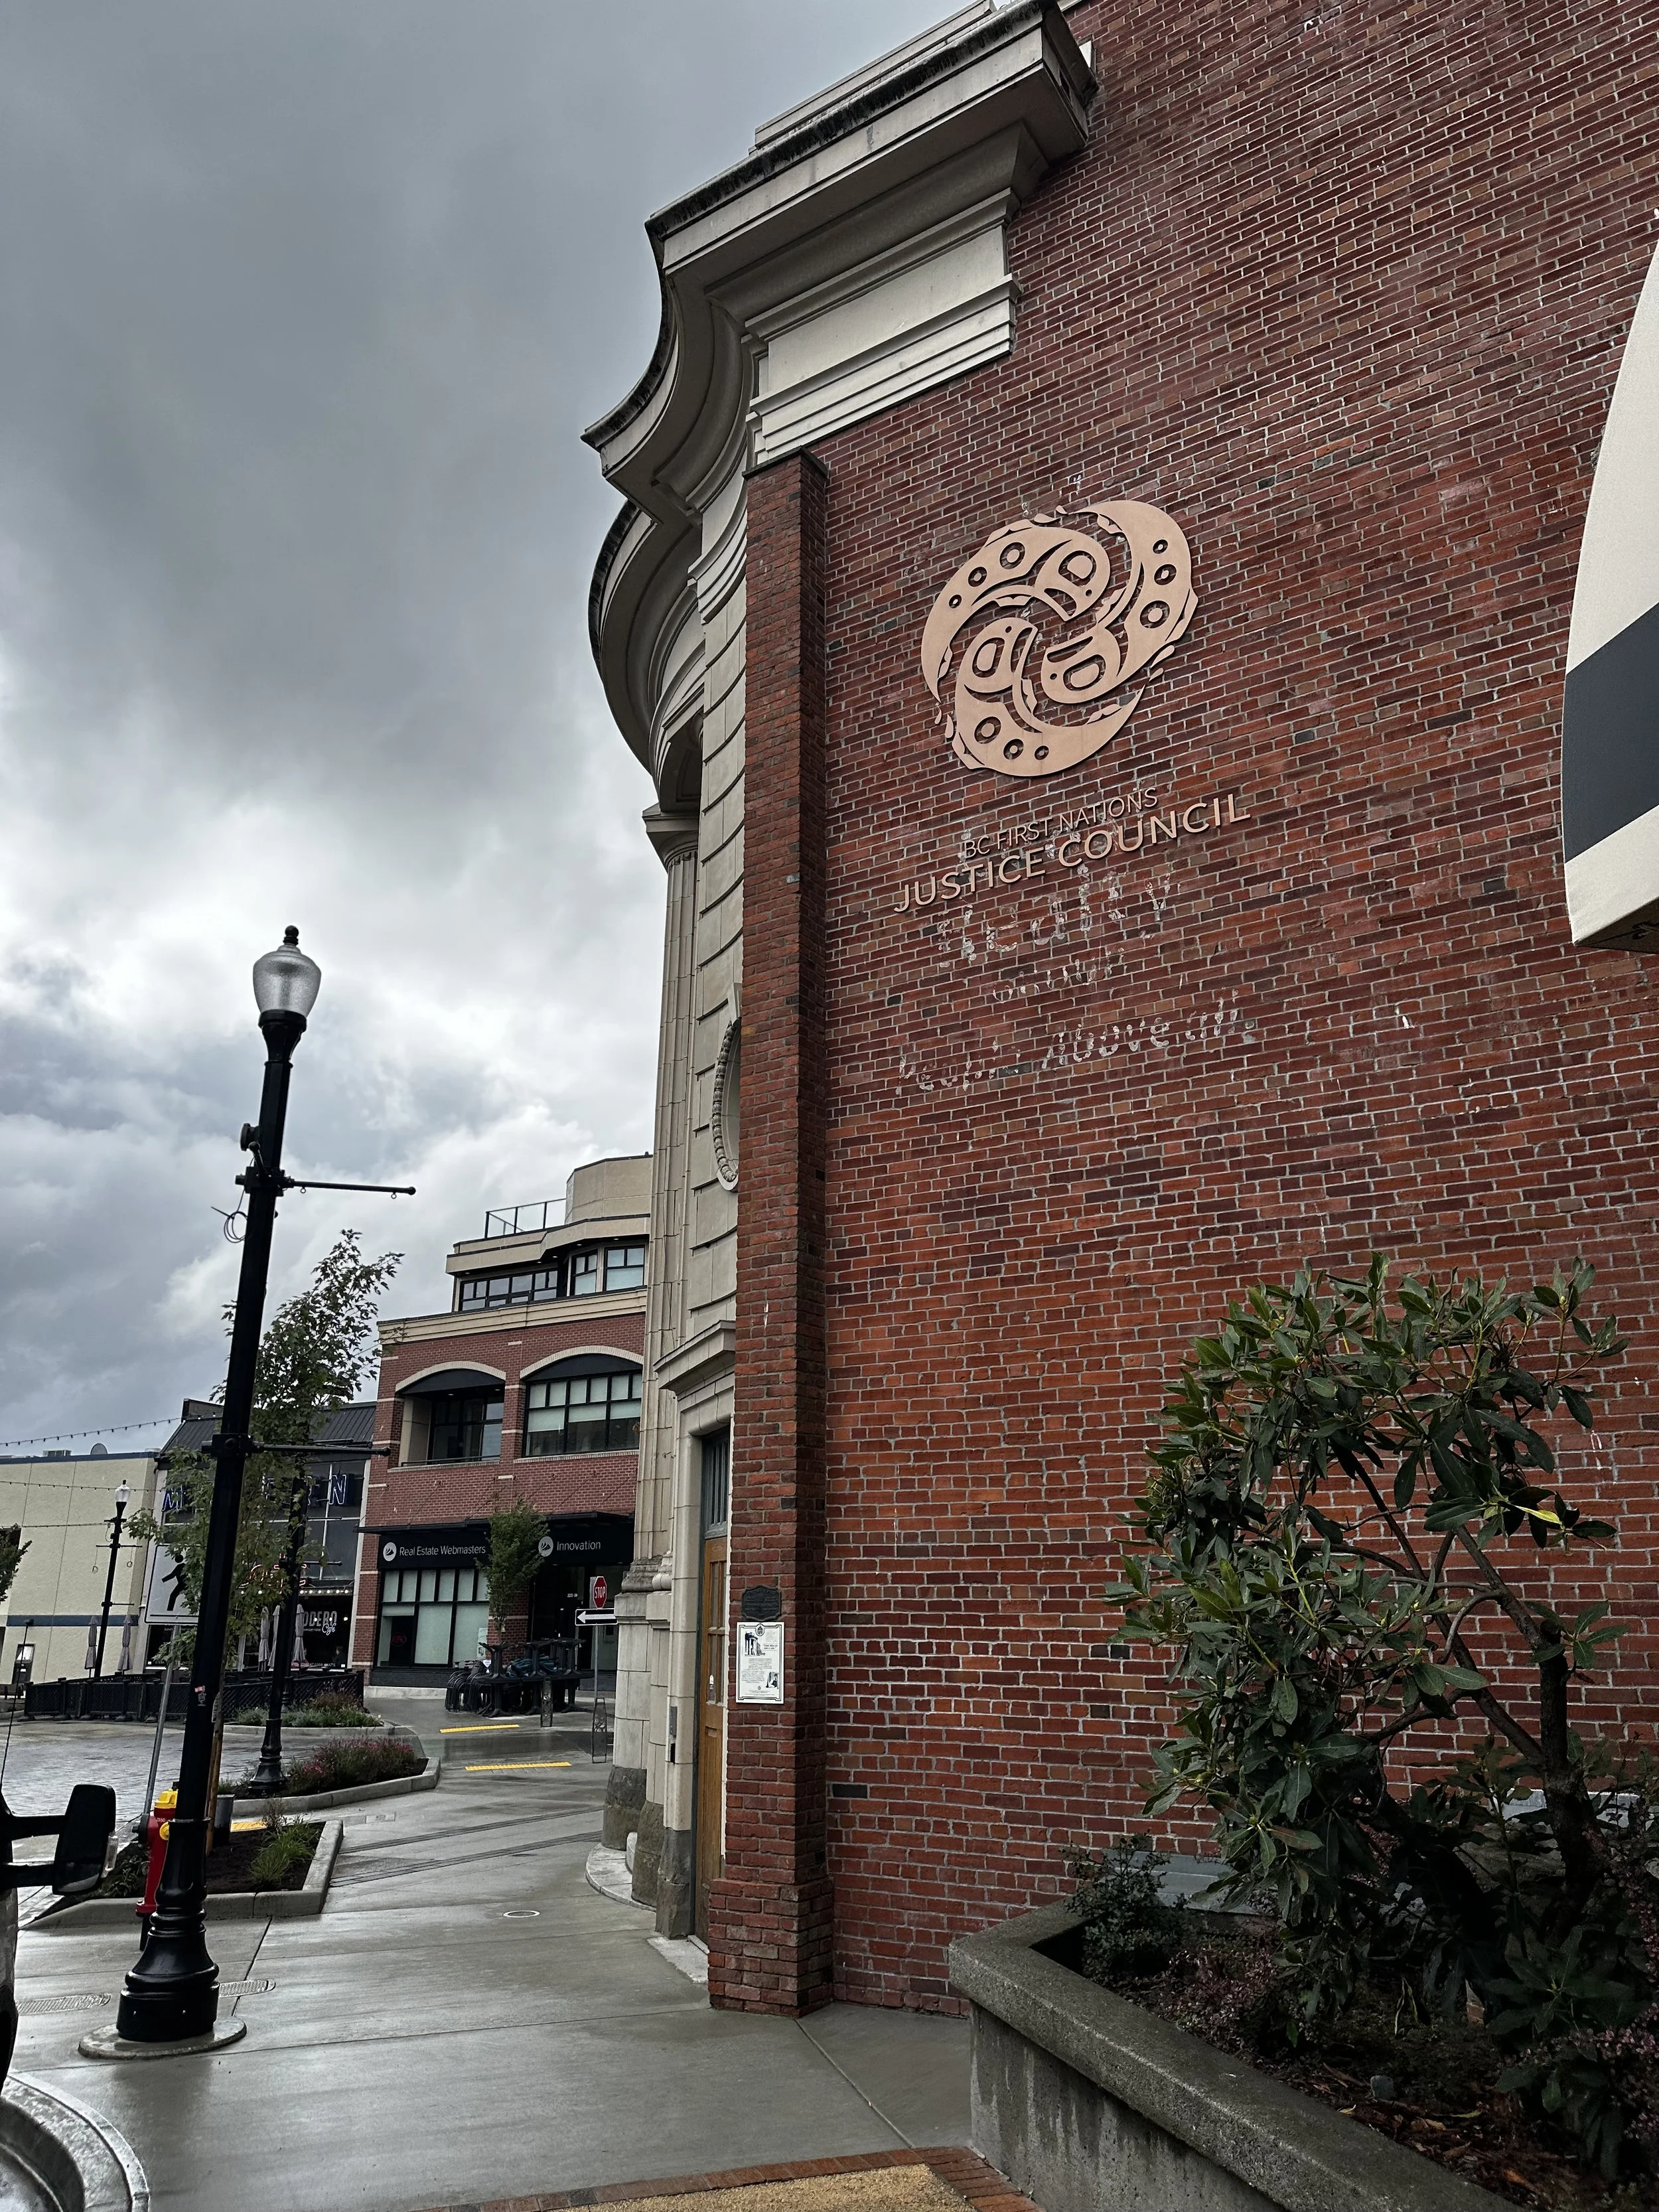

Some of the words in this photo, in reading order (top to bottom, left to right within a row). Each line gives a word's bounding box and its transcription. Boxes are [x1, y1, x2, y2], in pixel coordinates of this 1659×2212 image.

[964, 836, 990, 859] BC
[997, 817, 1053, 850] FIRST
[1059, 787, 1158, 832] NATIONS
[893, 847, 1046, 913] JUSTICE
[1058, 793, 1252, 867] COUNCIL
[399, 1546, 415, 1556] Real
[417, 1546, 439, 1556] Estate
[440, 1545, 486, 1555] Webmasters
[557, 1540, 601, 1551] Innovation
[595, 1586, 606, 1599] STOP
